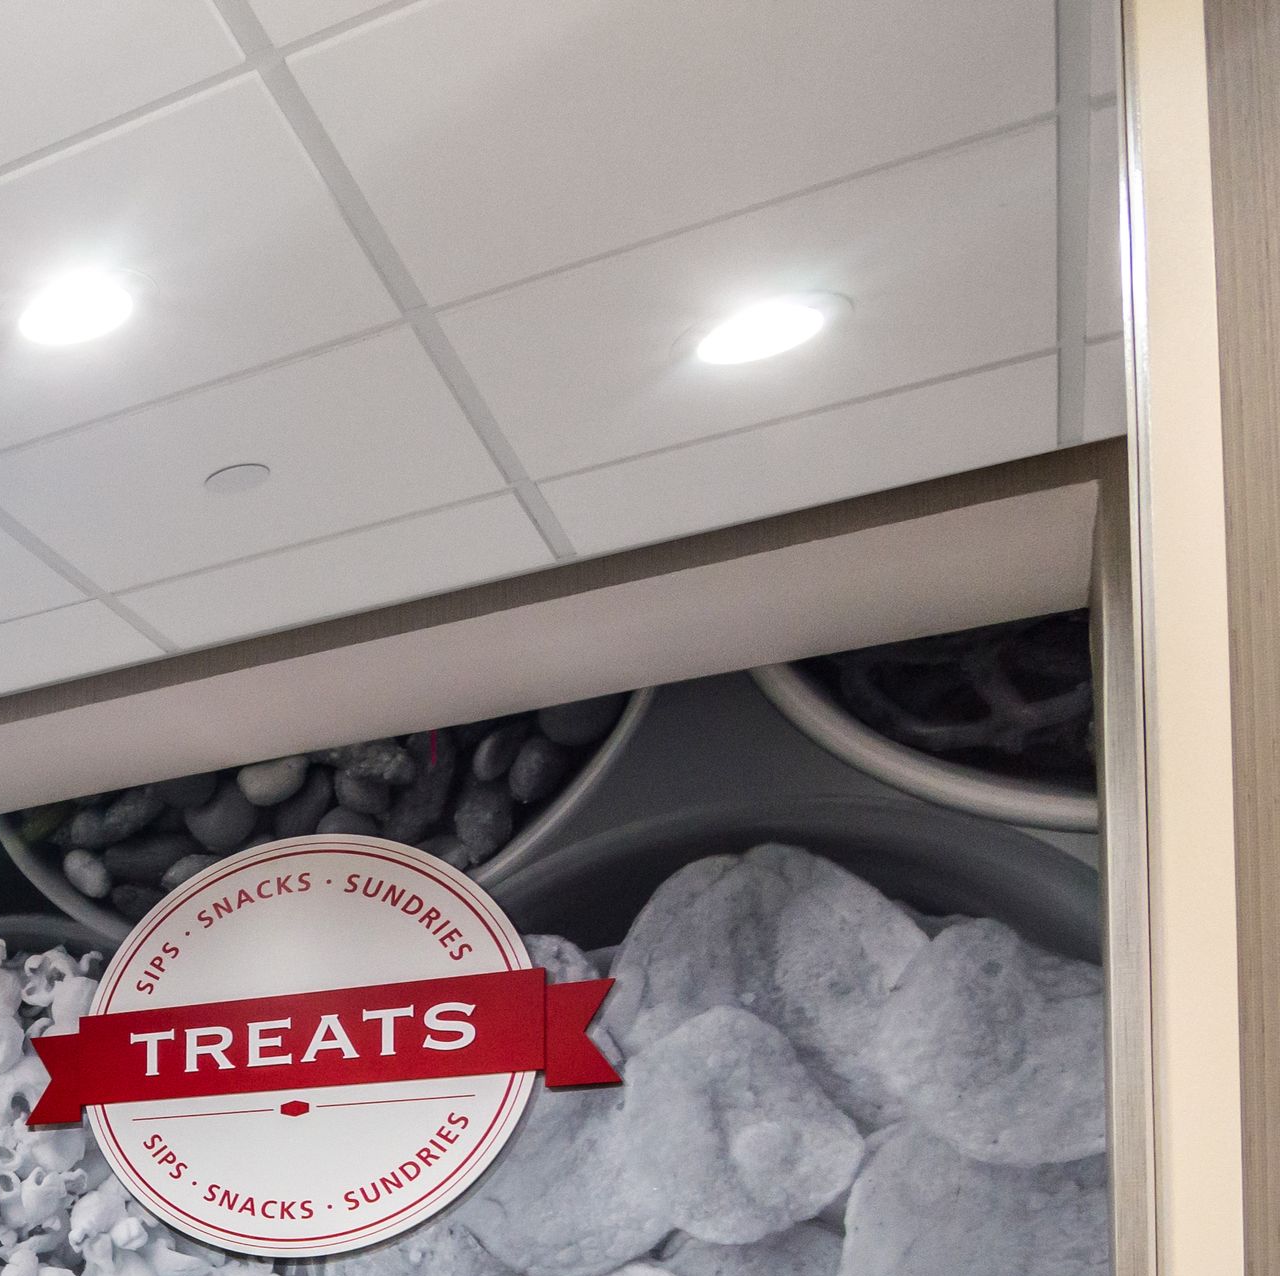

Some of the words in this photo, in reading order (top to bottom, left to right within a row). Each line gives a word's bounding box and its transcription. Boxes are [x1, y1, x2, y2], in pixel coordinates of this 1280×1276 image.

[135, 940, 181, 996] SIPS
[197, 871, 314, 930] SNACKS
[342, 872, 474, 963] SUNDRIES
[129, 1001, 478, 1079] TREATS
[141, 1132, 189, 1181] SIPS
[203, 1181, 316, 1222] SNACKS
[342, 1110, 471, 1212] SUNDRIES
